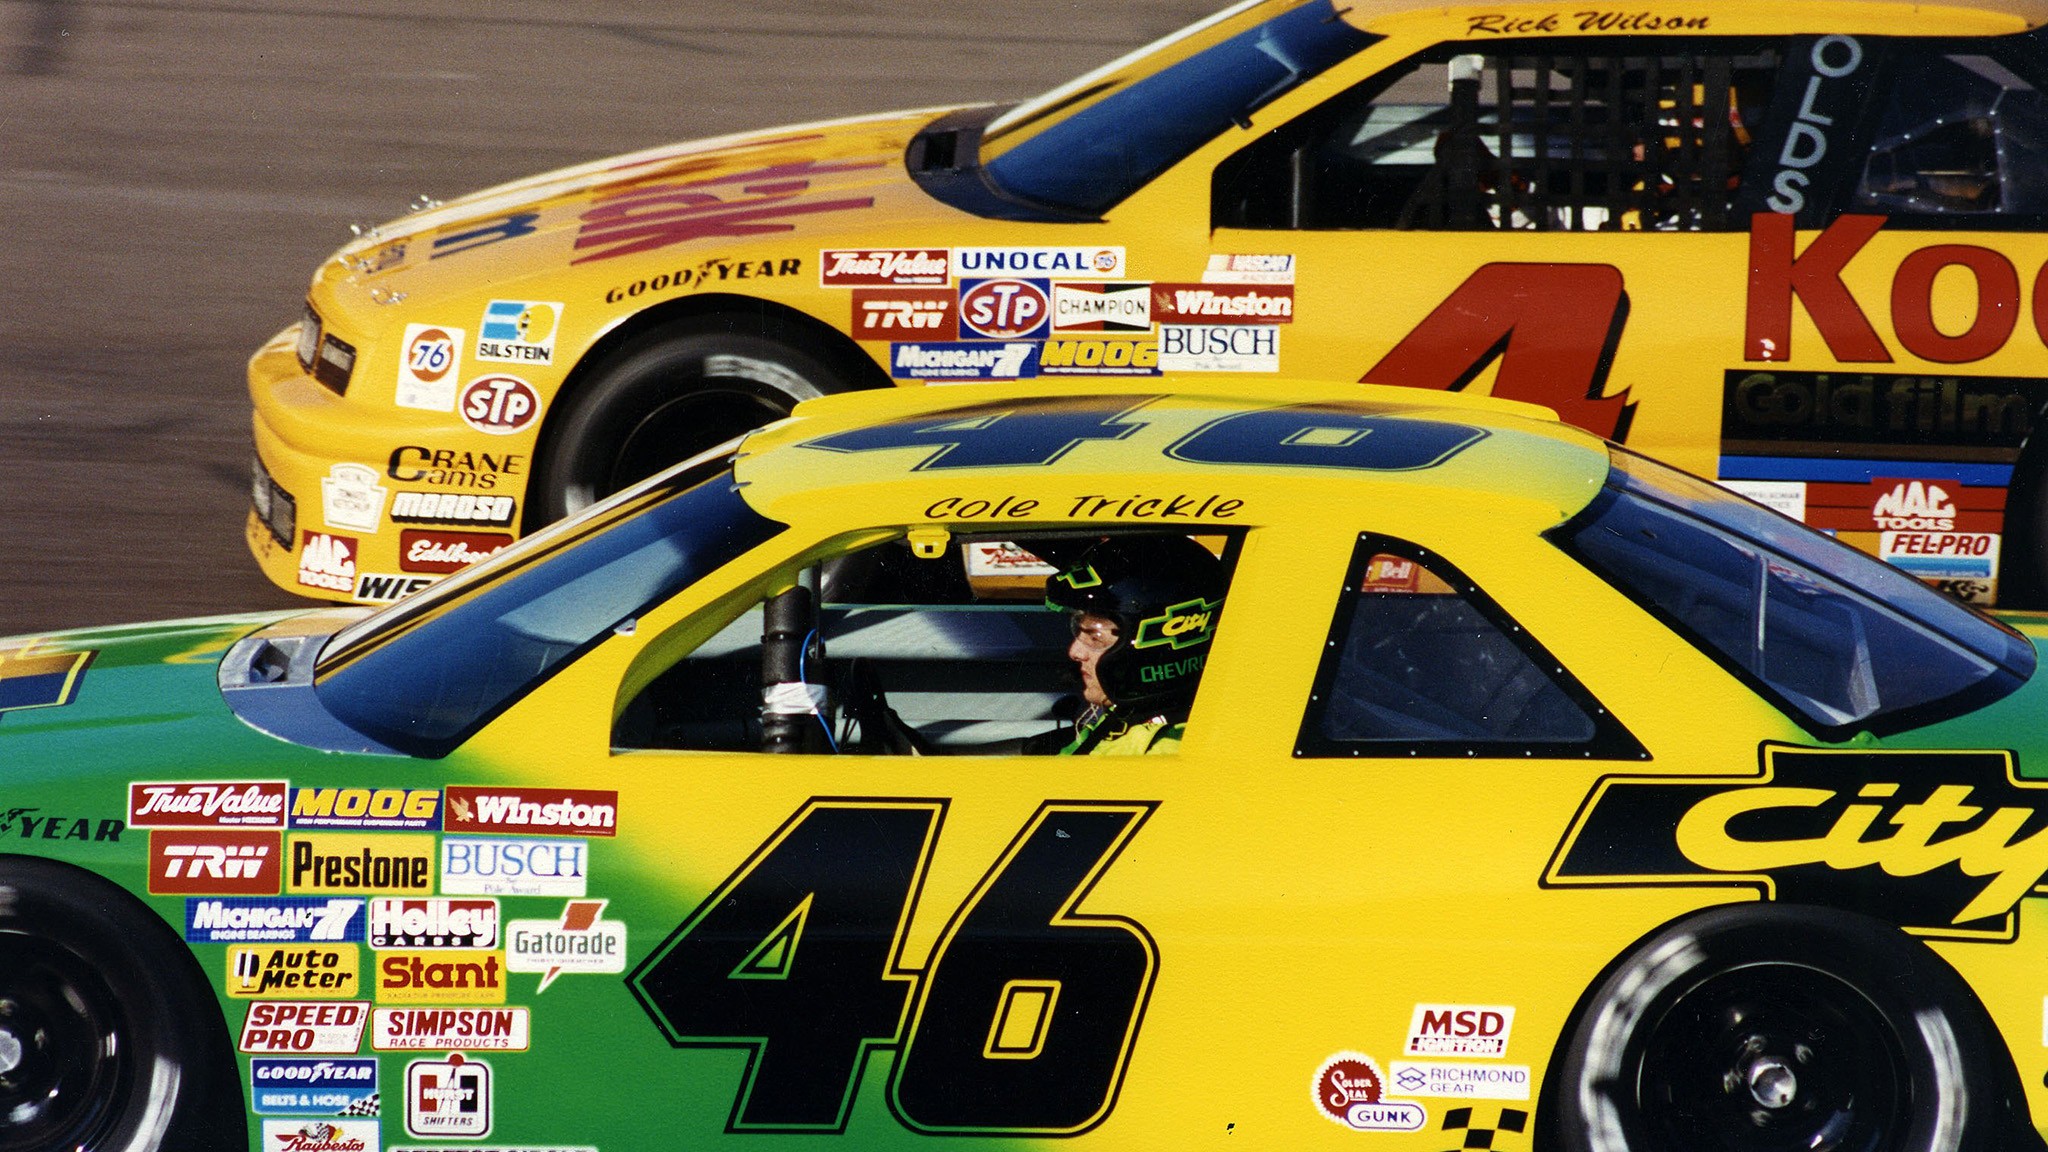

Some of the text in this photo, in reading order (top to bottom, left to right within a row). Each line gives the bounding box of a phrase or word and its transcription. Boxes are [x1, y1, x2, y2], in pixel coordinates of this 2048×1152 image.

[1467, 11, 1710, 36] Rick Wilson
[1766, 34, 1863, 215] OLDS
[961, 252, 1089, 270] UNOCAL
[1744, 213, 2048, 364] Ko
[861, 301, 949, 328] TRW
[970, 285, 1038, 327] STP
[1058, 299, 1146, 315] CHAMPION
[1174, 290, 1292, 316] Winston
[479, 342, 550, 361] BILSTEIN
[1039, 341, 1159, 367] MOOG
[1163, 327, 1277, 356] BUSCH
[1357, 261, 1640, 446] 4
[415, 342, 447, 369] 76
[896, 345, 995, 367] MICHIGAN
[466, 381, 530, 424] STP
[794, 393, 1493, 473] 46
[924, 494, 1244, 518] Cole Trickle
[1872, 481, 1956, 518] MAC
[1873, 517, 1956, 530] TOOLS
[300, 533, 355, 577] MAC
[1891, 533, 1991, 555] FEL-PRO
[298, 568, 353, 592] TOOLS
[1379, 561, 1412, 579] Bell
[1161, 611, 1212, 636] City
[291, 788, 440, 818] MOOG
[475, 796, 614, 827] Winston
[163, 845, 269, 878] TRW
[292, 841, 428, 888] Prestone
[445, 843, 582, 878] BUSCH
[1675, 782, 2048, 925] City
[192, 901, 315, 929] MICHIGAN
[373, 900, 496, 947] Holley
[372, 936, 462, 947] CARBS
[515, 930, 616, 955] Gatorade
[266, 950, 340, 969] Auto
[622, 796, 1163, 1139] 46
[261, 969, 353, 990] Meter
[382, 956, 499, 989] Stant
[250, 1005, 360, 1027] SPEED
[387, 1011, 513, 1037] SIMPSON
[1419, 1010, 1505, 1037] MSD
[244, 1029, 315, 1050] PRO
[389, 1038, 509, 1047] RACE PRODUCTS
[1416, 1038, 1500, 1053] IGNITION
[256, 1064, 373, 1081] GOODYEAR
[1430, 1067, 1526, 1084] RICHMOND
[261, 1094, 350, 1106] BELTS & HOSE
[423, 1088, 474, 1101] HURST
[1430, 1084, 1475, 1094] GEAR
[423, 1116, 474, 1126] SHIFTERS
[1357, 1110, 1411, 1123] GUNK
[278, 1134, 366, 1152] Raybestos
